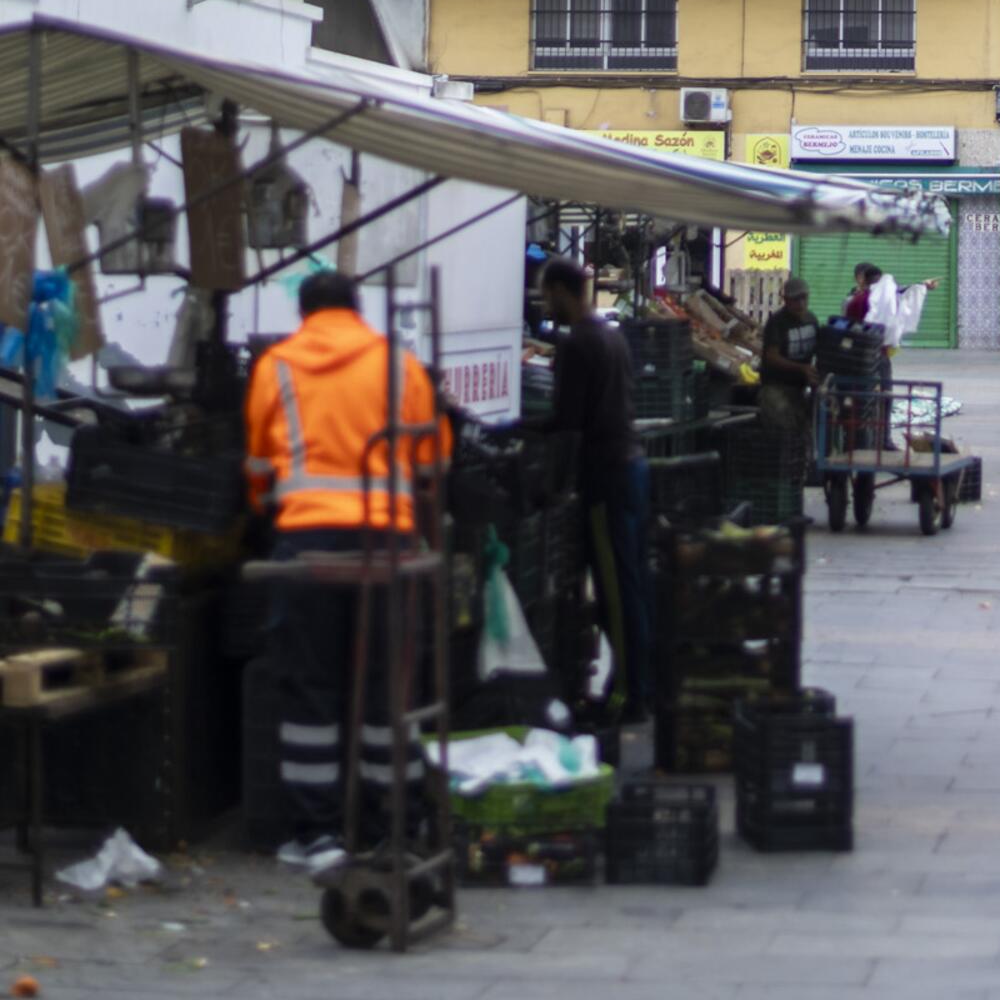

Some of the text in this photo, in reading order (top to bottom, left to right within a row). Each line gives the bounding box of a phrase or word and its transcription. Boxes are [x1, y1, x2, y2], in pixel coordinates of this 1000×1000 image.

[654, 131, 695, 147] Sazón
[849, 144, 895, 153] MENAJE COCINA
